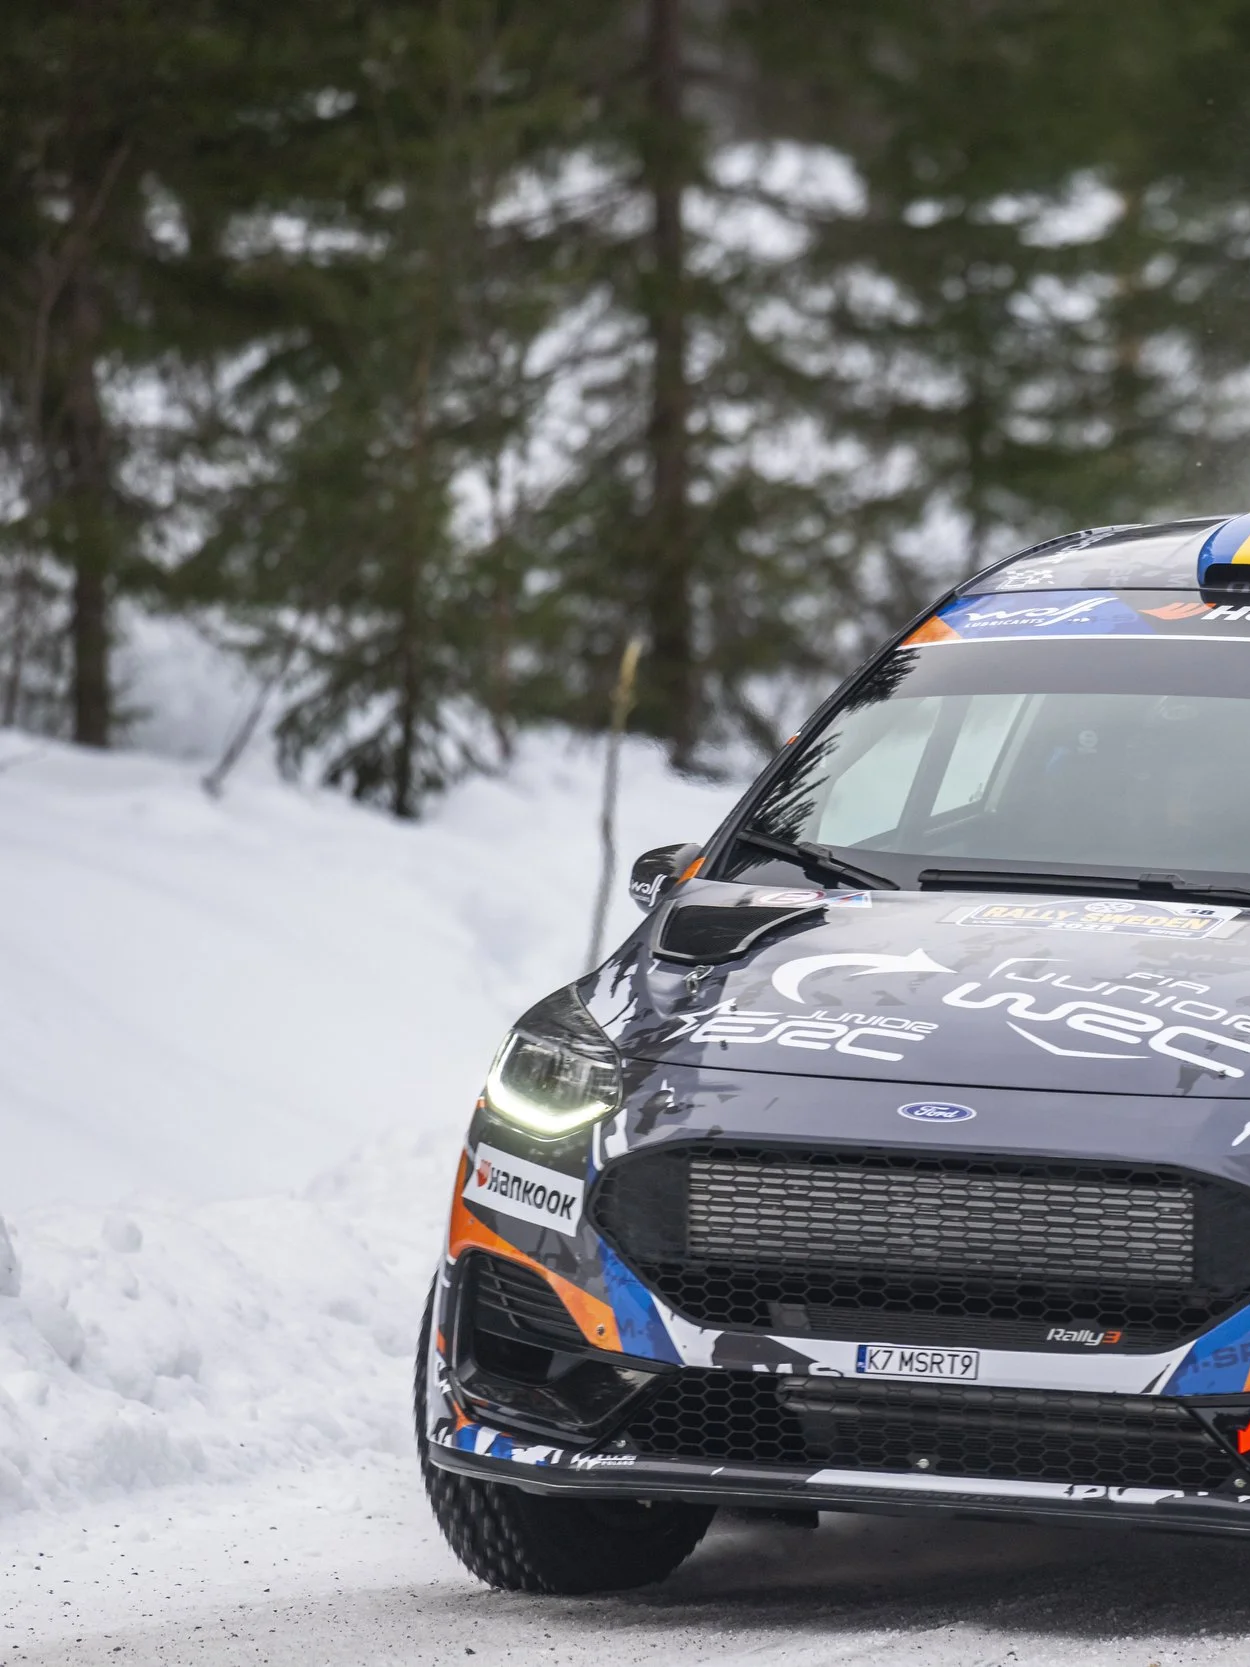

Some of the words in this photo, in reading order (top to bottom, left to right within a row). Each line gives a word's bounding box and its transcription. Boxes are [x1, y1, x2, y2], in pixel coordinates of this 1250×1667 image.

[965, 616, 1045, 629] LUBRICANTS
[982, 905, 1079, 922] RALLY
[1079, 911, 1213, 931] SWEDEN
[1047, 922, 1116, 932] 2025
[1126, 972, 1211, 995] FIA
[787, 1010, 938, 1034] JUNIOR
[689, 1016, 905, 1062] ERC
[914, 1105, 960, 1119] Ford
[1047, 1328, 1122, 1346] Rally3
[867, 1348, 893, 1371] K7
[899, 1351, 974, 1376] MSRT9
